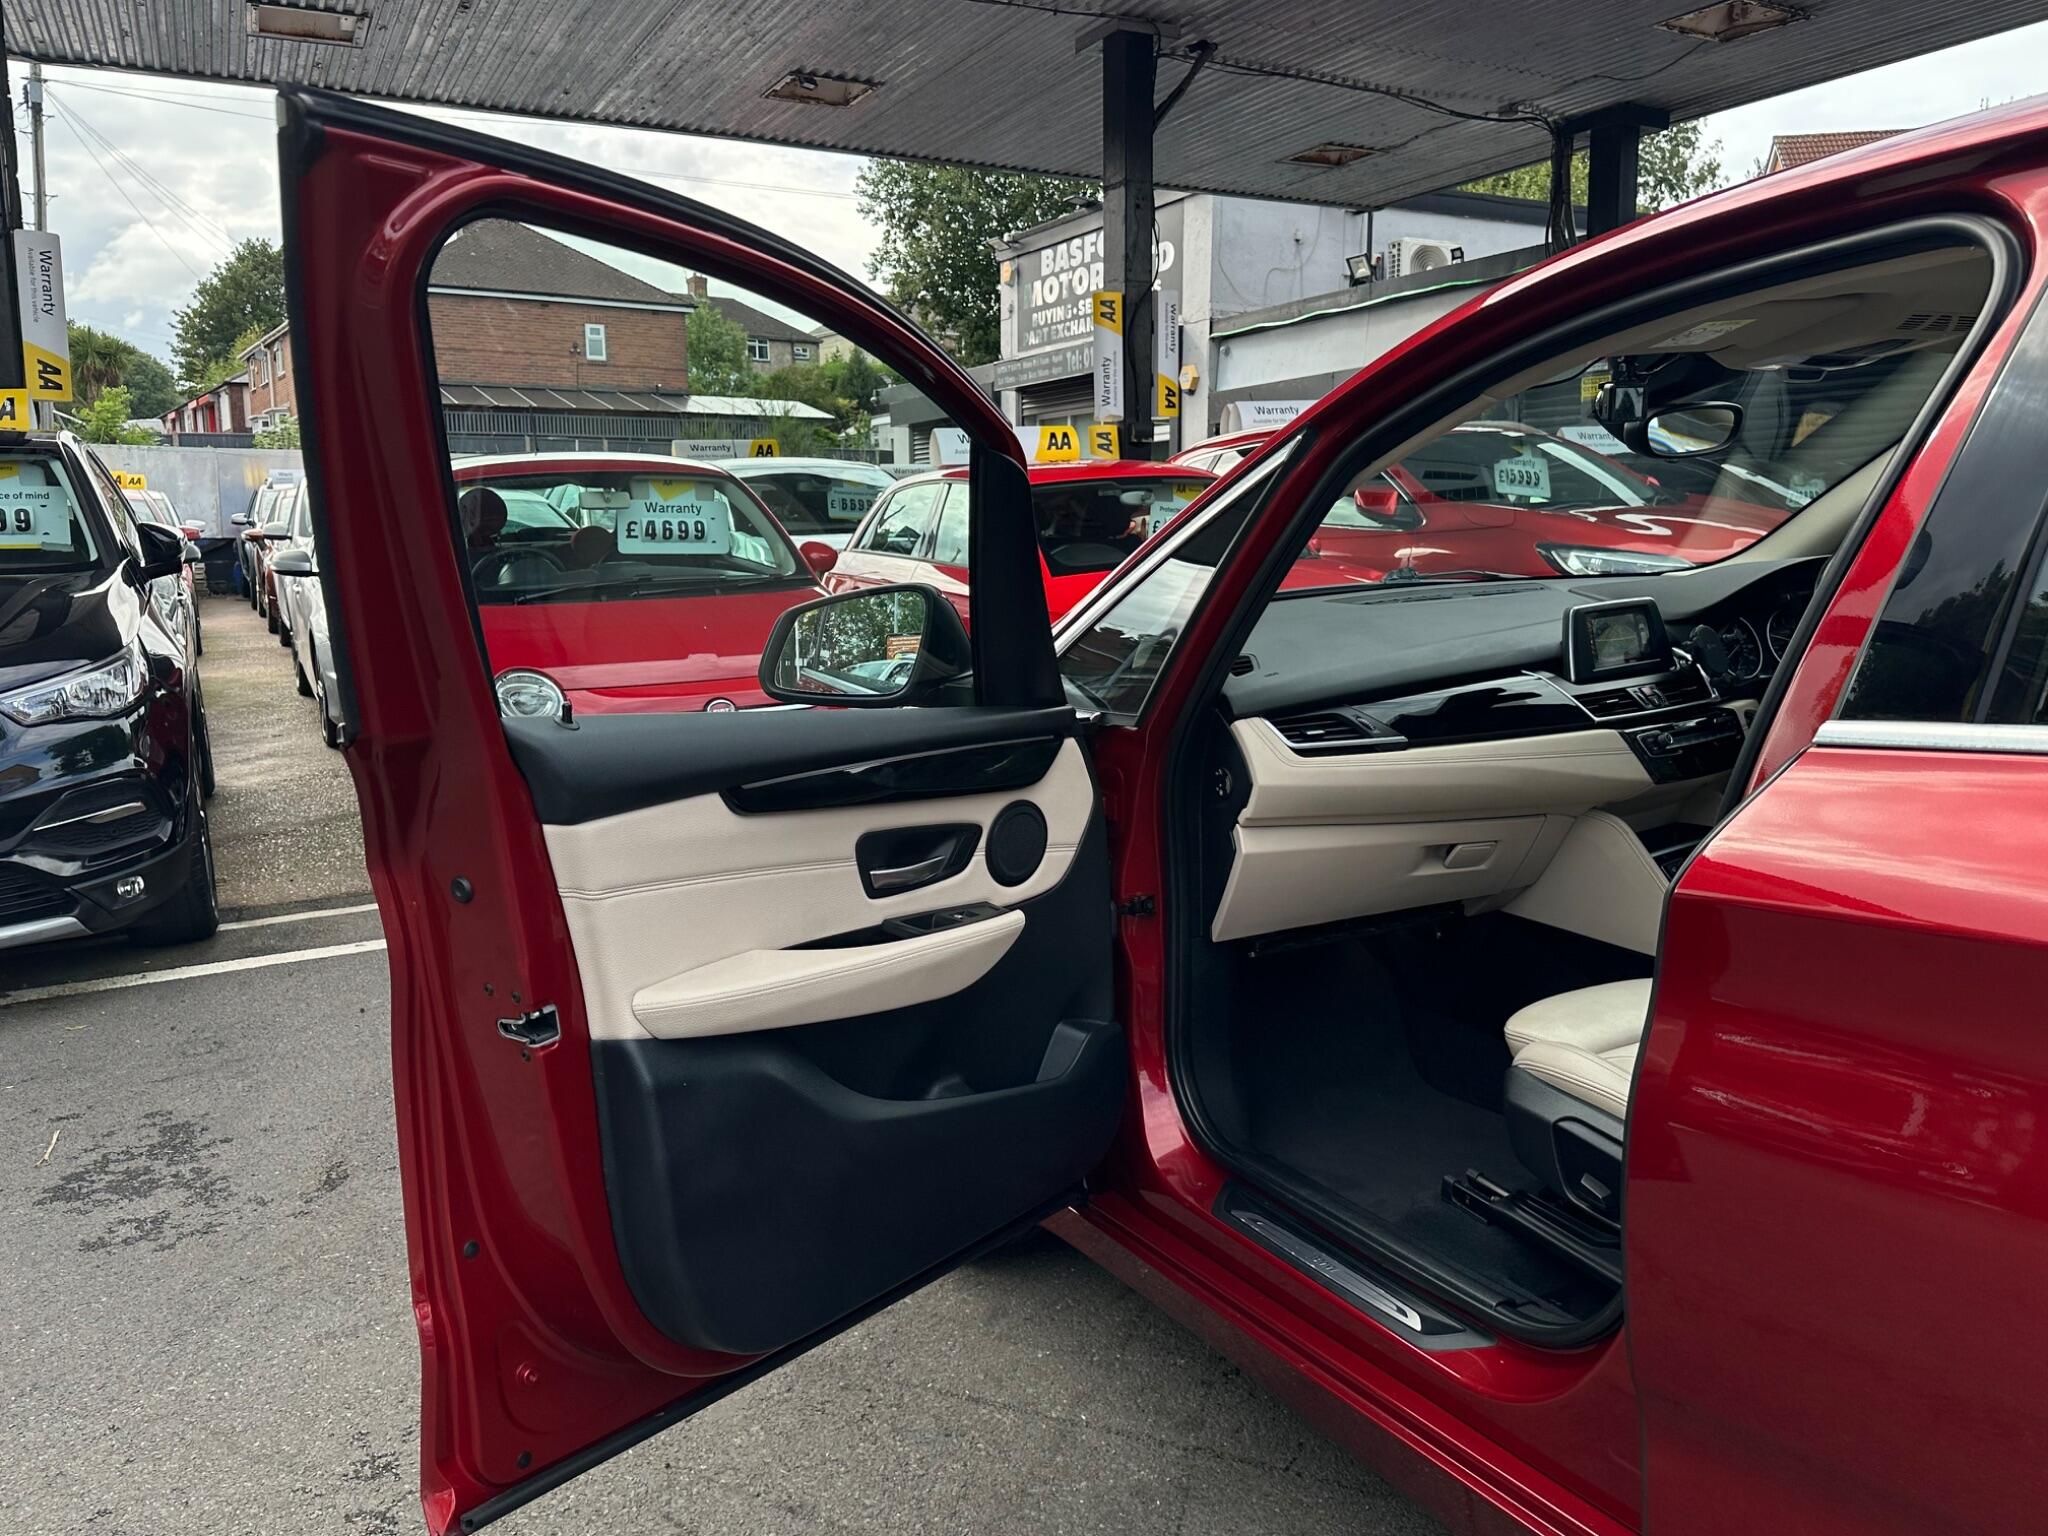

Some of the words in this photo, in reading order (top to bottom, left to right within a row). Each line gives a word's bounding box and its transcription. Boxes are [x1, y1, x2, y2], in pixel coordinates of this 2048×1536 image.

[39, 250, 56, 316] Warranty
[1099, 299, 1116, 323] AA
[1051, 317, 1095, 336] EXCHAN
[1169, 303, 1177, 354] Warranty
[36, 358, 63, 391] AA
[1102, 356, 1112, 407] Warranty
[1164, 386, 1177, 409] AA
[0, 397, 16, 421] A
[1254, 405, 1299, 416] Warranty
[689, 444, 731, 453] Warranty
[756, 444, 774, 457] AA
[1047, 432, 1072, 450] AA
[1096, 431, 1113, 454] AA
[128, 476, 142, 485] AA
[13, 492, 23, 500] of
[25, 491, 50, 500] mind
[644, 502, 702, 516] Warranty
[626, 520, 706, 541] £4699
